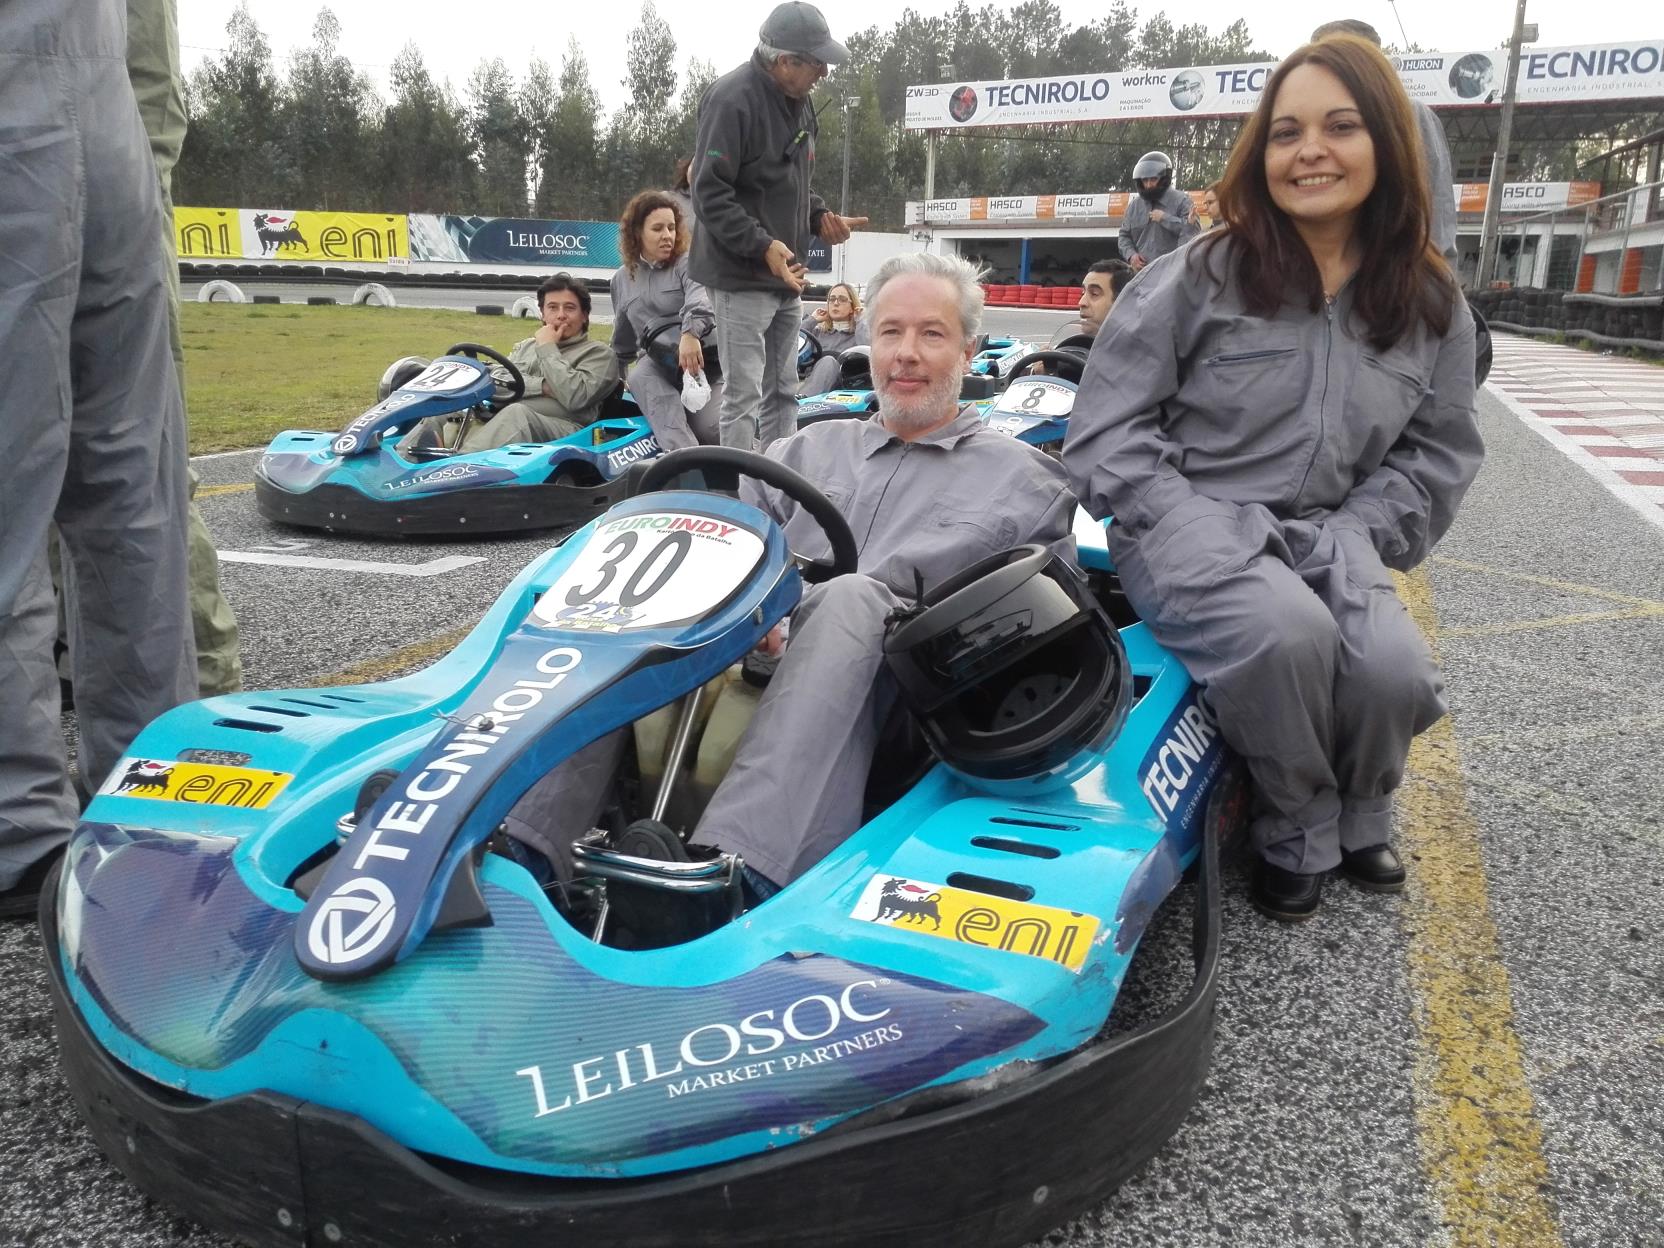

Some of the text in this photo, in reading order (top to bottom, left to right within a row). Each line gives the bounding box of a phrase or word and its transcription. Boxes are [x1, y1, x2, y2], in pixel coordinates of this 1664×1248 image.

[1405, 60, 1440, 70] HURON
[1520, 46, 1664, 79] ECNIRO
[1122, 73, 1166, 87] worknc
[985, 78, 1109, 108] TECNIROLO
[1057, 197, 1093, 208] HASCO
[1503, 186, 1545, 198] ASCO
[927, 201, 957, 212] HASCO
[990, 199, 1022, 210] HASCO
[320, 217, 398, 259] eni
[507, 230, 588, 249] LEILOSOC
[414, 365, 460, 387] 24
[1022, 387, 1046, 409] 8
[384, 464, 479, 490] LEILOSOC
[604, 516, 738, 538] EUROINDY
[565, 530, 692, 608] 30
[353, 647, 583, 871] TECNIROLO
[174, 771, 283, 808] eni
[955, 907, 1084, 965] eni
[515, 979, 892, 1118] LEILOSOC
[667, 1023, 903, 1099] MARKET PARTNERS
